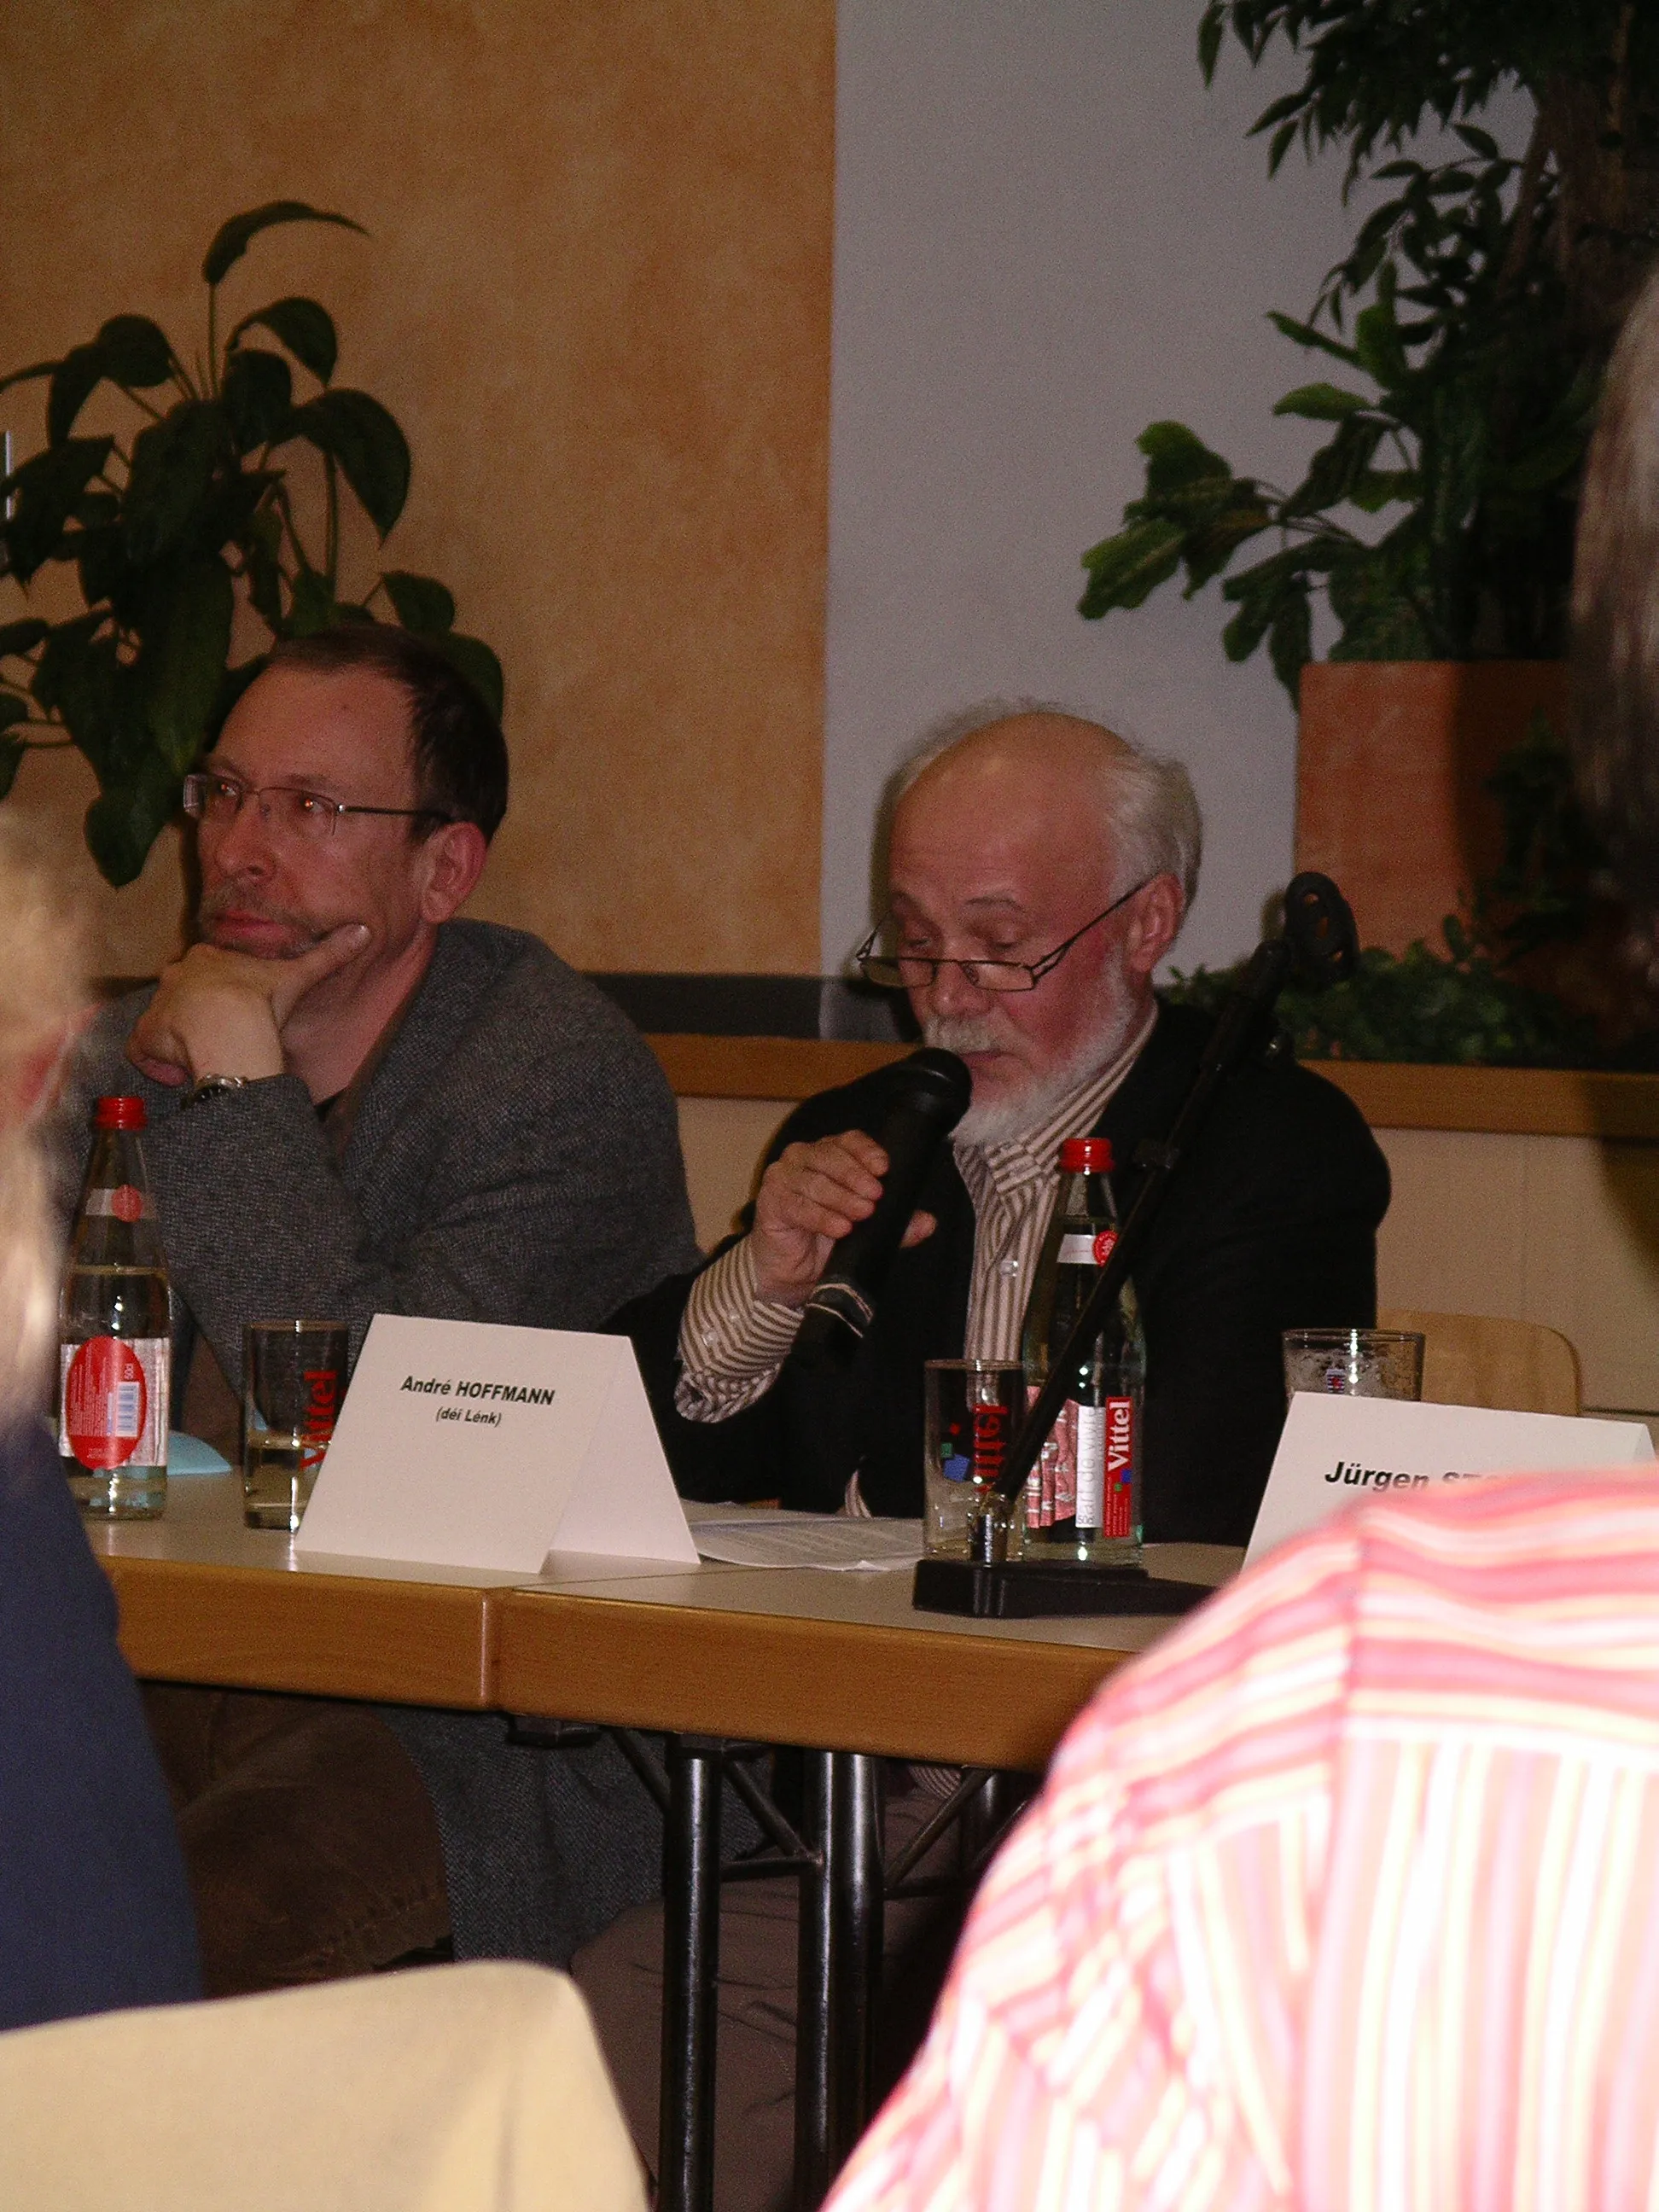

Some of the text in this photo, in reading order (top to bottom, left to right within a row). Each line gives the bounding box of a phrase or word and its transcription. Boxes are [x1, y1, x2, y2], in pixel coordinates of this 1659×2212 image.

[399, 1376, 556, 1406] André HOFFMANN
[464, 1409, 503, 1428] Lénk)
[1108, 1401, 1130, 1471] Vittel
[1324, 1461, 1430, 1493] Jürgen
